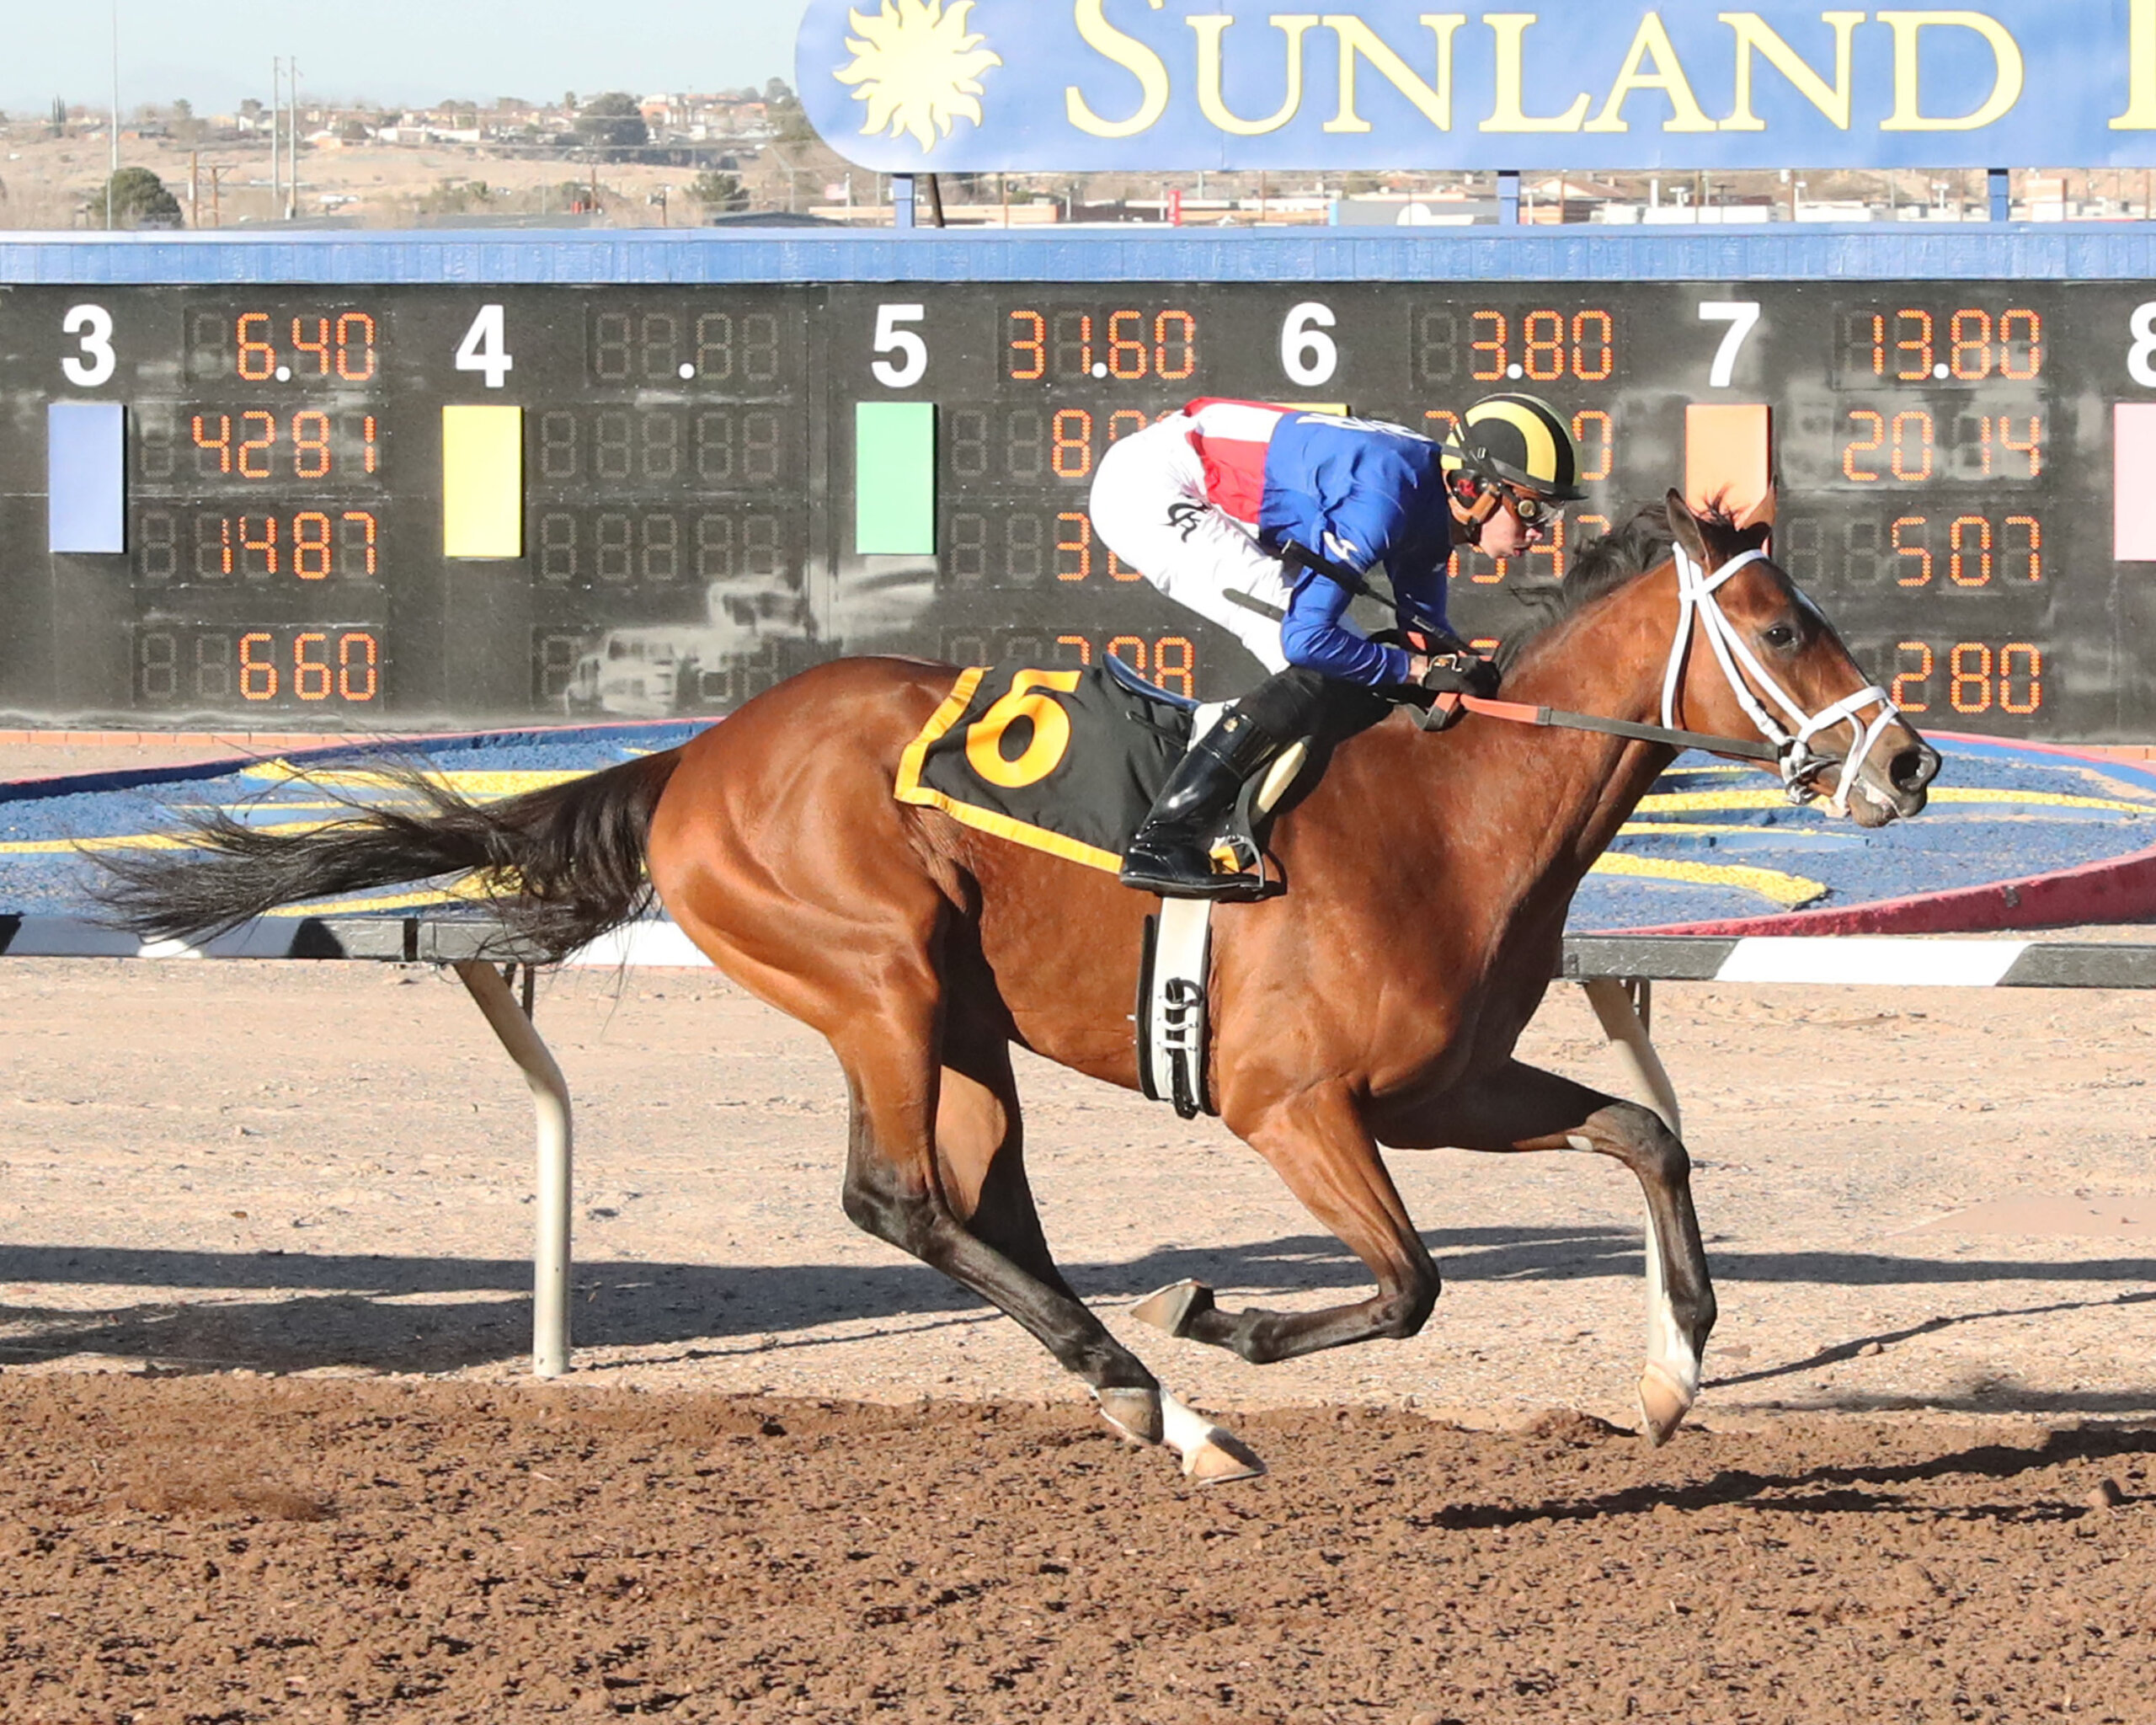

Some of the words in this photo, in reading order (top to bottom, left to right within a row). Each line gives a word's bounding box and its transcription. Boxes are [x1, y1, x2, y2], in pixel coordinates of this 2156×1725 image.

[1065, 0, 2024, 136] SUNLAND
[62, 304, 116, 387] 3
[236, 312, 375, 382] 6.40
[455, 305, 513, 387] 4
[871, 304, 928, 387] 5
[1009, 310, 1195, 380] 31.60
[1280, 302, 1338, 387] 6
[1471, 310, 1614, 382] 3.80
[1699, 302, 1760, 387] 7
[1872, 308, 2042, 381] 13.80
[192, 410, 376, 478] 4281
[221, 511, 376, 580] 1487
[1891, 515, 2042, 587] 507
[239, 633, 377, 702] 660
[1890, 641, 2042, 714] 280
[965, 668, 1082, 788] 6
